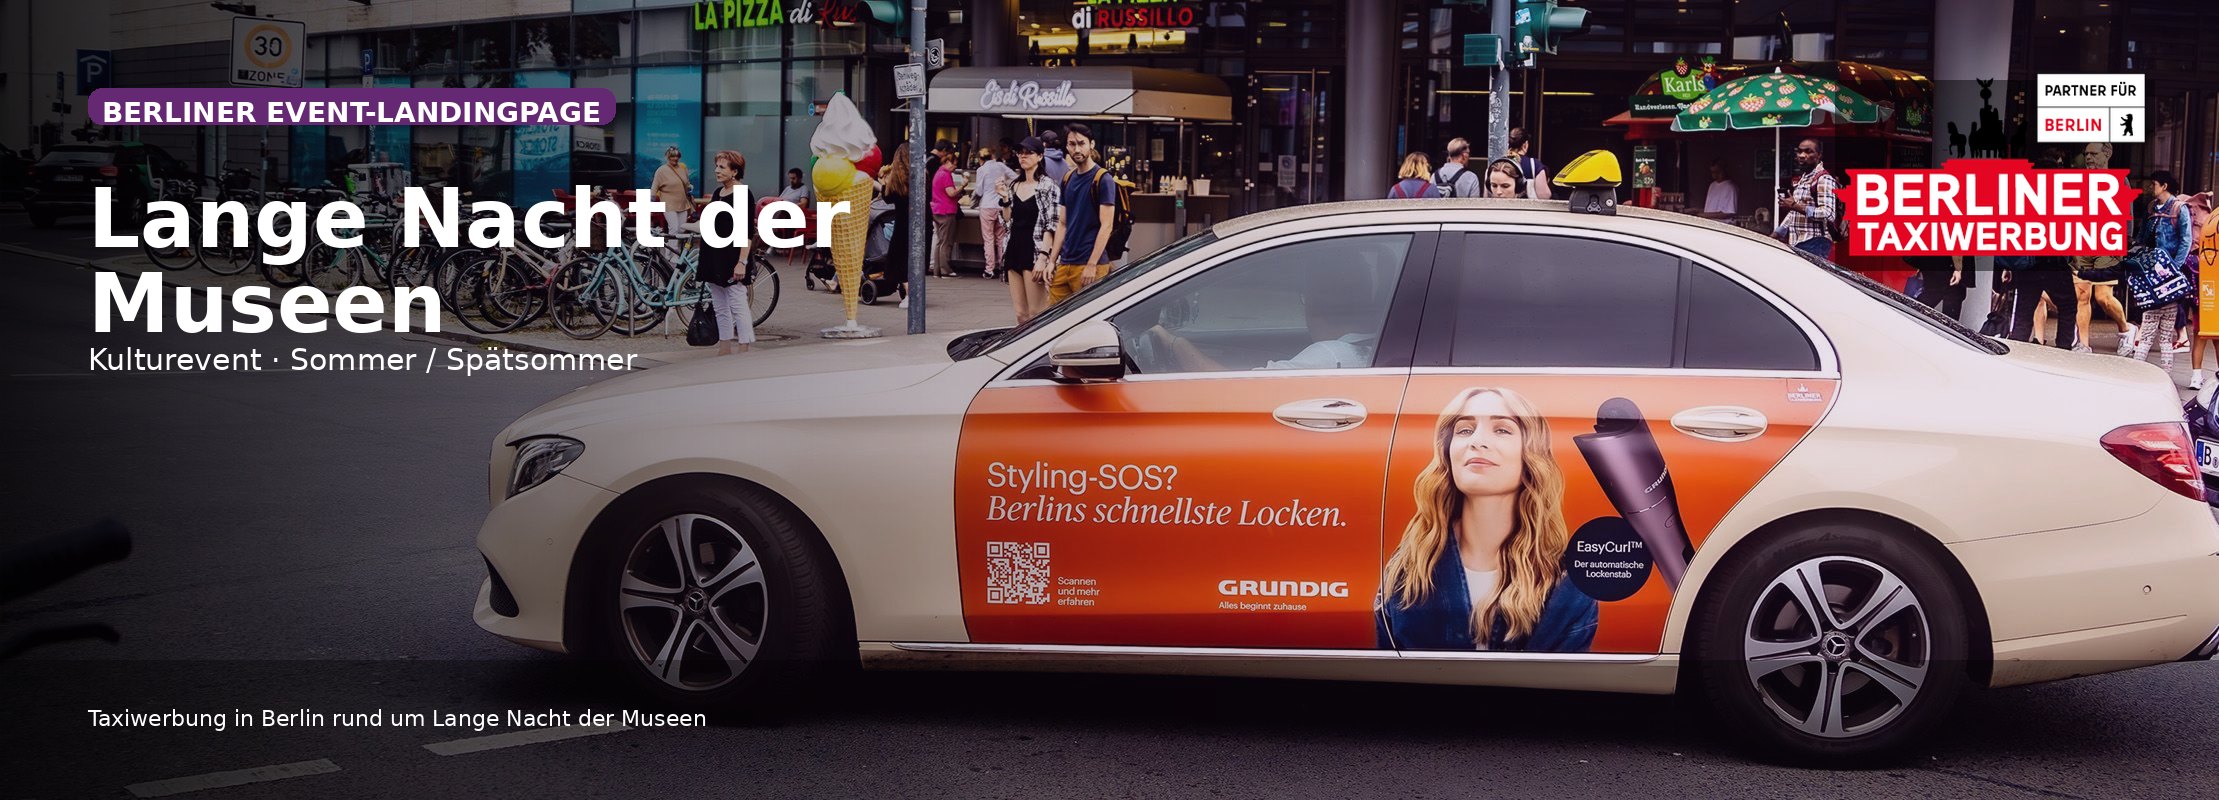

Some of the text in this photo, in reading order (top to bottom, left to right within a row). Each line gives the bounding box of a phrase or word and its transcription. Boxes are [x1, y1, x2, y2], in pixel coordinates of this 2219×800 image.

[693, 1, 718, 31] LA
[722, 0, 784, 29] PIZZA
[789, 0, 813, 24] di
[1072, 5, 1194, 30] di RUSSILLO
[254, 36, 282, 57] 30
[86, 62, 103, 83] P
[1664, 75, 1705, 93] Karls
[980, 79, 1078, 110] Eis di Russillo
[987, 461, 1178, 496] Styling-SOS?
[987, 496, 1347, 527] Berlins schnellste Locken.
[1574, 560, 1644, 570] Der automatische
[1586, 570, 1632, 579] Lockenstab
[1058, 576, 1097, 586] Scannen
[1218, 579, 1349, 598] GRUNDIG
[1058, 587, 1100, 596] und mehr
[1058, 597, 1095, 606] erfahren
[1218, 601, 1307, 611] Alles beginnt zuhause
